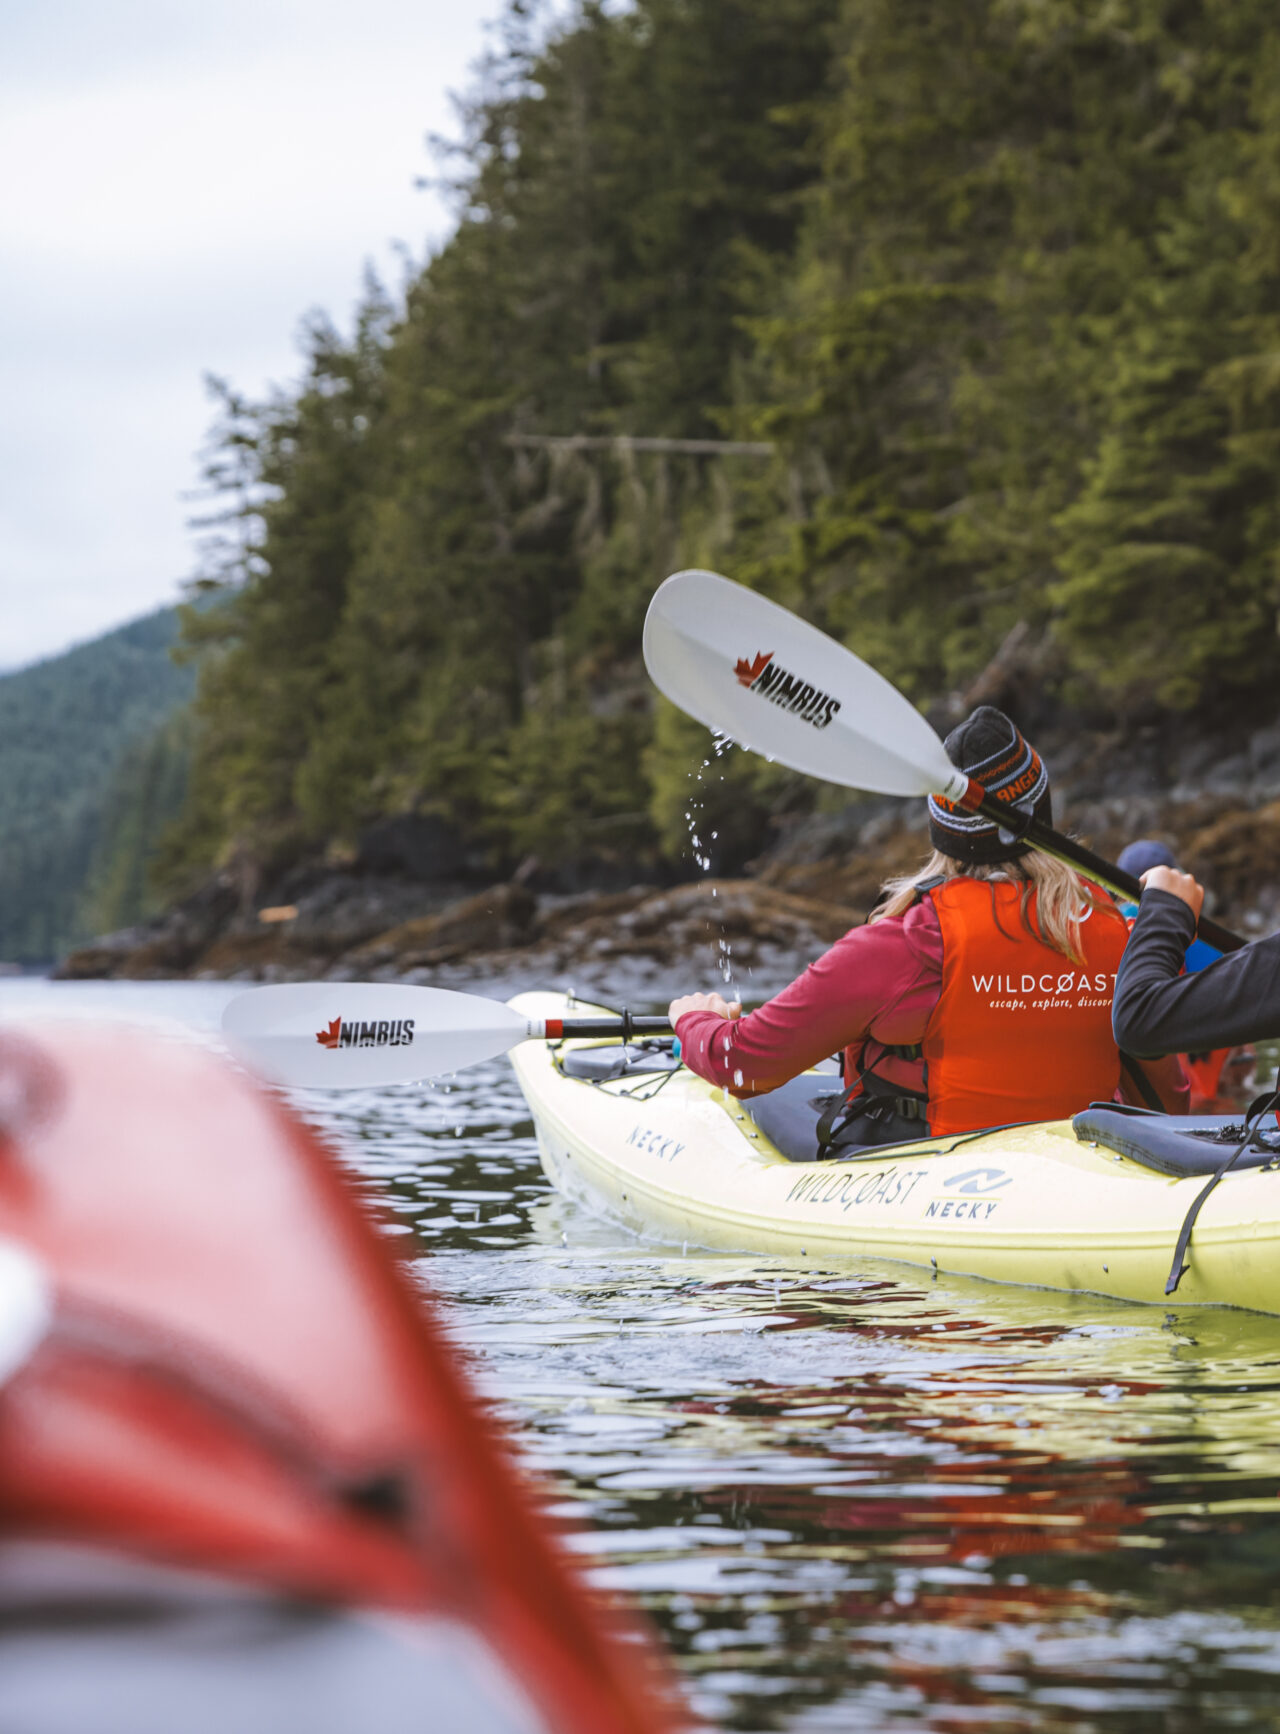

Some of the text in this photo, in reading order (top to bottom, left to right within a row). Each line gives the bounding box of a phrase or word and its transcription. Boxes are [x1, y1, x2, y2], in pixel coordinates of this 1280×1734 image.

[750, 661, 842, 731] NIMBUS
[989, 999, 1027, 1011] escape,
[1032, 996, 1073, 1011] explore,
[340, 1019, 415, 1048] NIMBUS
[625, 1124, 686, 1162] NECKY
[925, 1201, 998, 1219] NECKY
